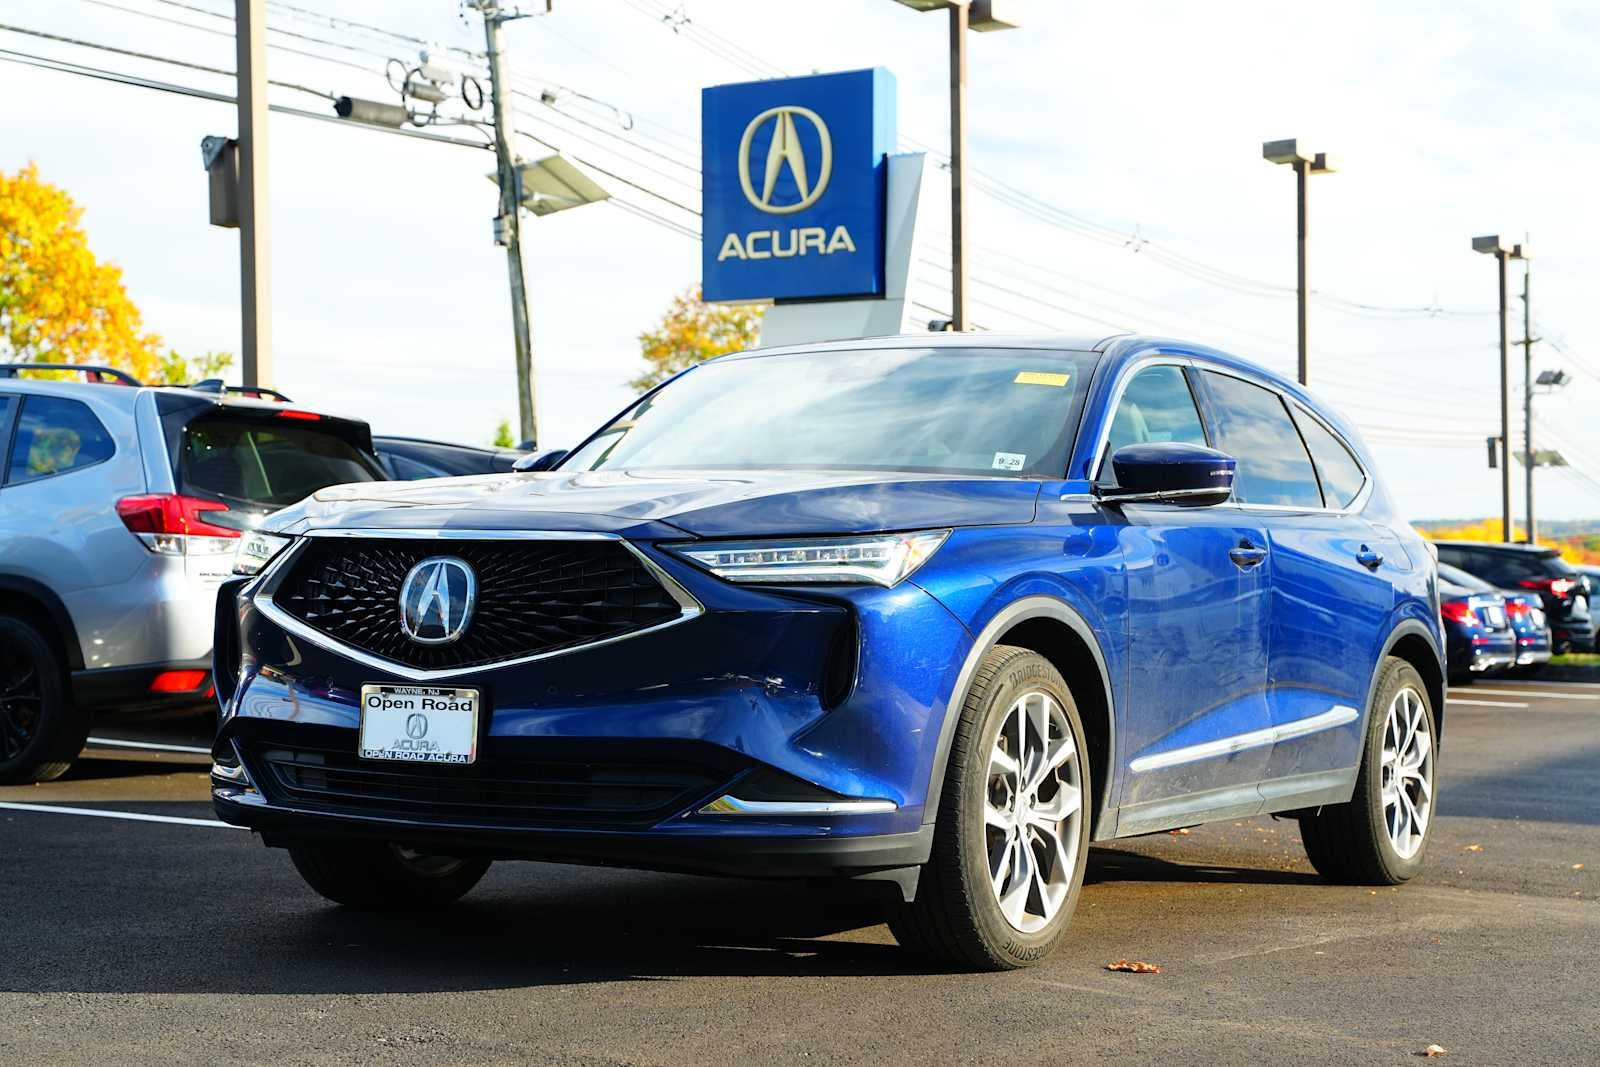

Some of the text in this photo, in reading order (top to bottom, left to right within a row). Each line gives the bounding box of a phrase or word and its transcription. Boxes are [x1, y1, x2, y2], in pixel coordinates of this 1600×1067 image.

[718, 225, 856, 262] ACURA
[428, 688, 440, 696] NJ
[368, 696, 472, 711] Open Road
[391, 739, 440, 752] ACURA
[365, 750, 466, 763] OPEN ROAD ACURA
